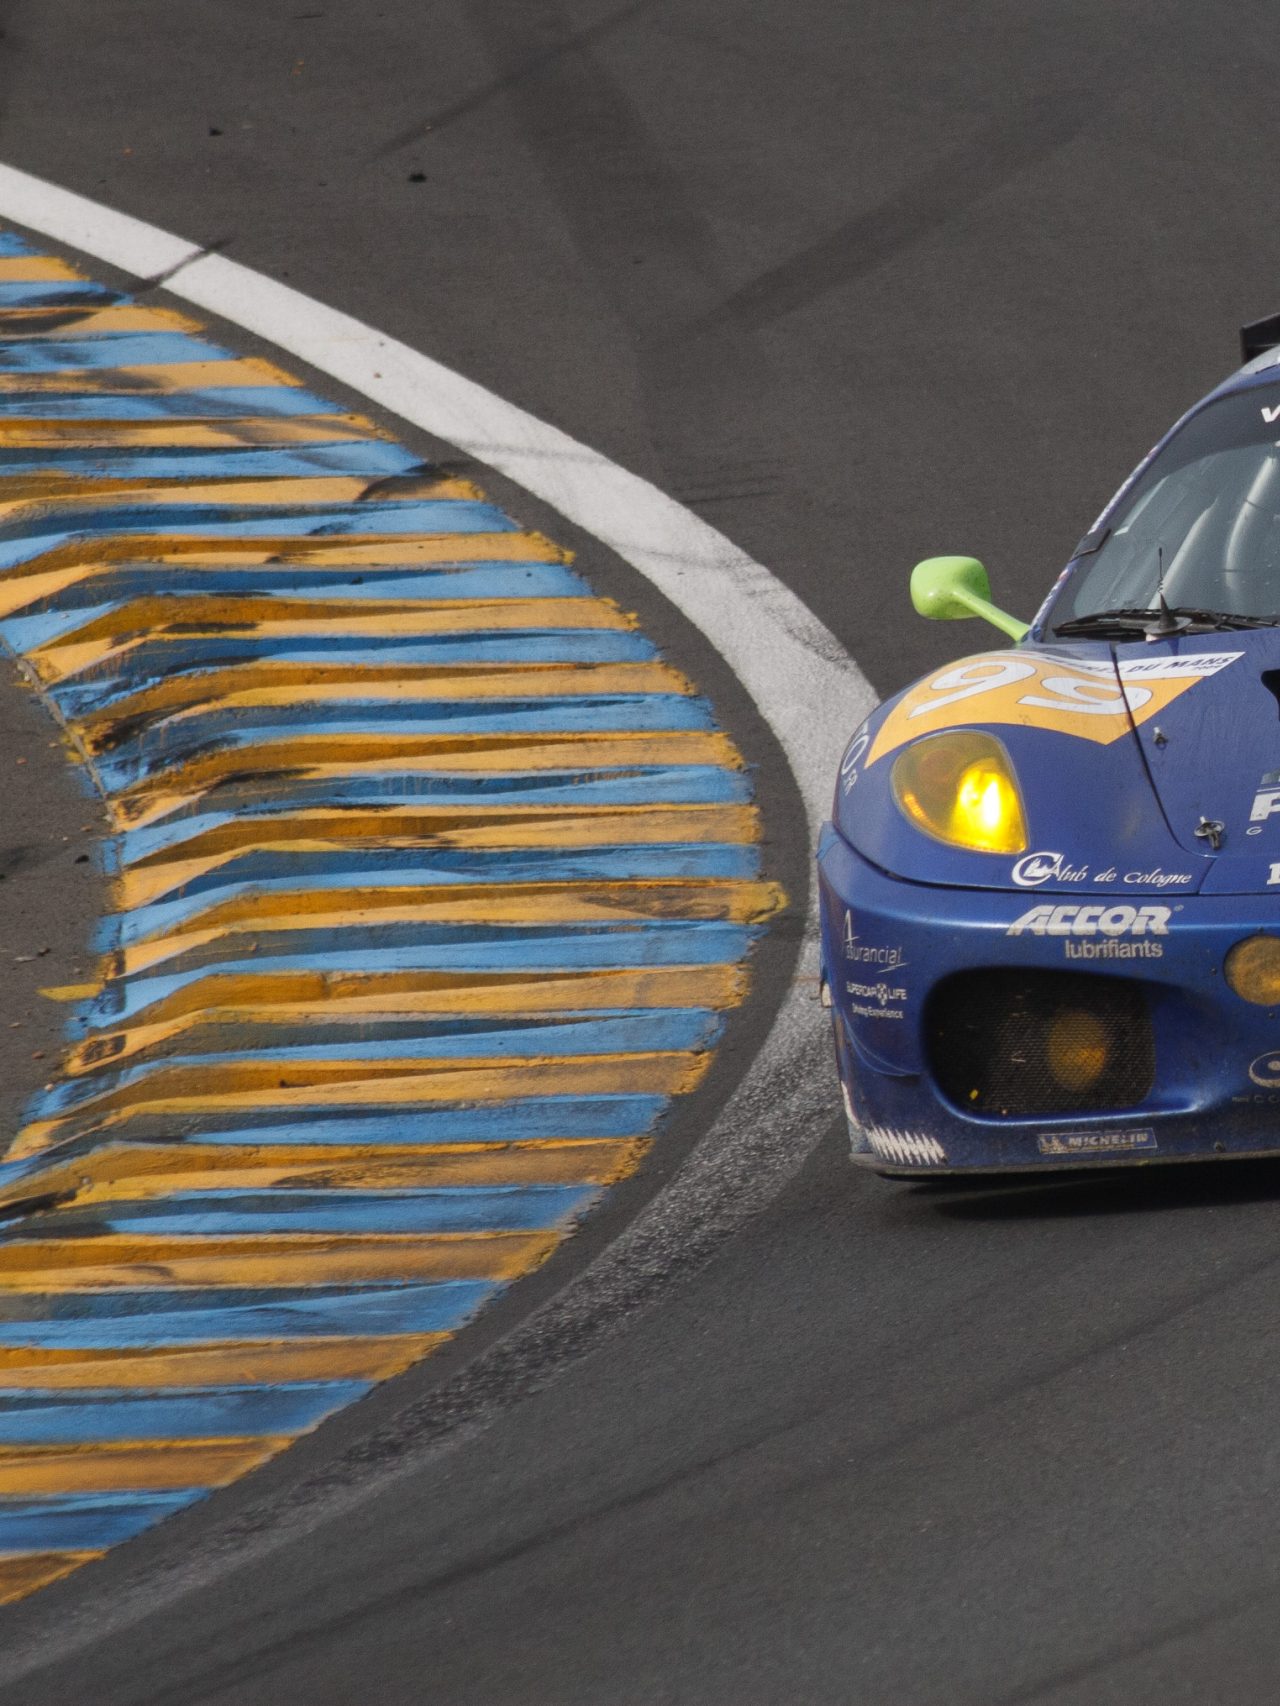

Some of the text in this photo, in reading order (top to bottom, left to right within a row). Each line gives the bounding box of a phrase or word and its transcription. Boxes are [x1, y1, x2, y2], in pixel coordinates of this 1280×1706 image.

[1165, 656, 1234, 670] MANS
[1094, 867, 1116, 882] de
[1124, 867, 1191, 888] Cologne
[1006, 905, 1171, 937] ACCOR
[1065, 939, 1163, 960] lubrifiants
[888, 988, 907, 1000] LIFE
[1068, 1132, 1148, 1146] MICHELIN
